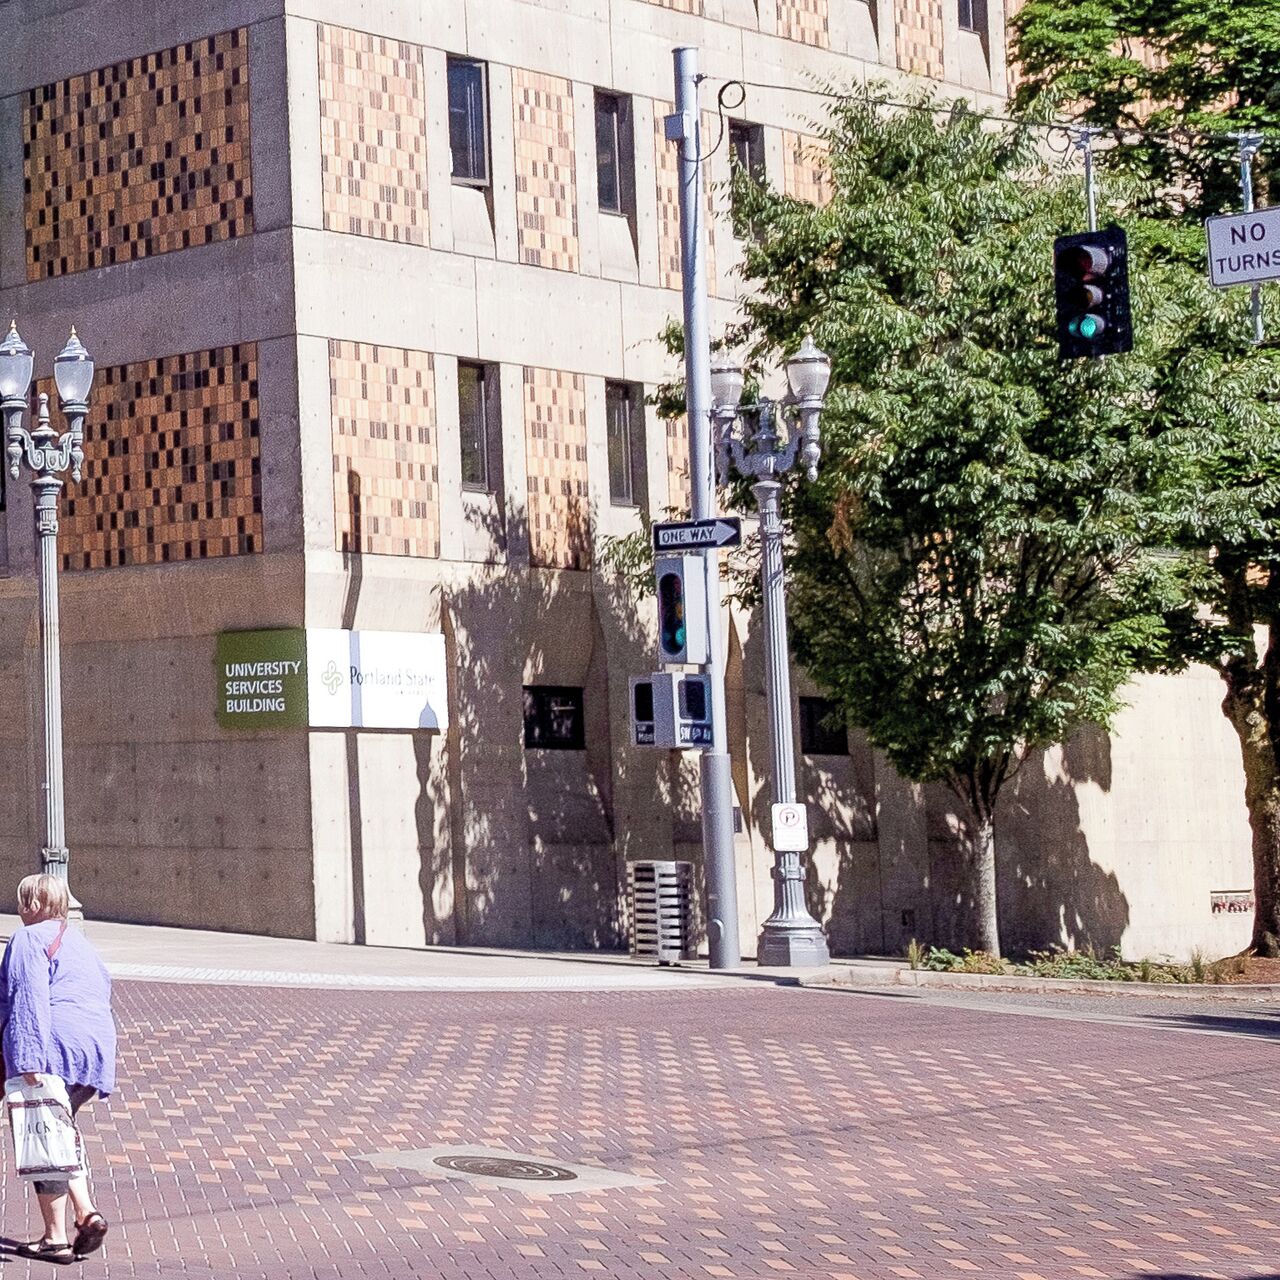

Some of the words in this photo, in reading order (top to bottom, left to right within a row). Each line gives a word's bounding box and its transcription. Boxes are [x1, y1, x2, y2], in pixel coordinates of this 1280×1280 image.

[1230, 222, 1266, 245] NO
[1216, 250, 1280, 274] TURNS
[661, 530, 686, 544] ONE
[690, 528, 715, 542] WAY
[225, 660, 301, 677] UNIVERSITY
[349, 665, 402, 686] Portland
[405, 668, 435, 686] State
[225, 680, 283, 695] SERVICES
[226, 698, 285, 713] BUILDING
